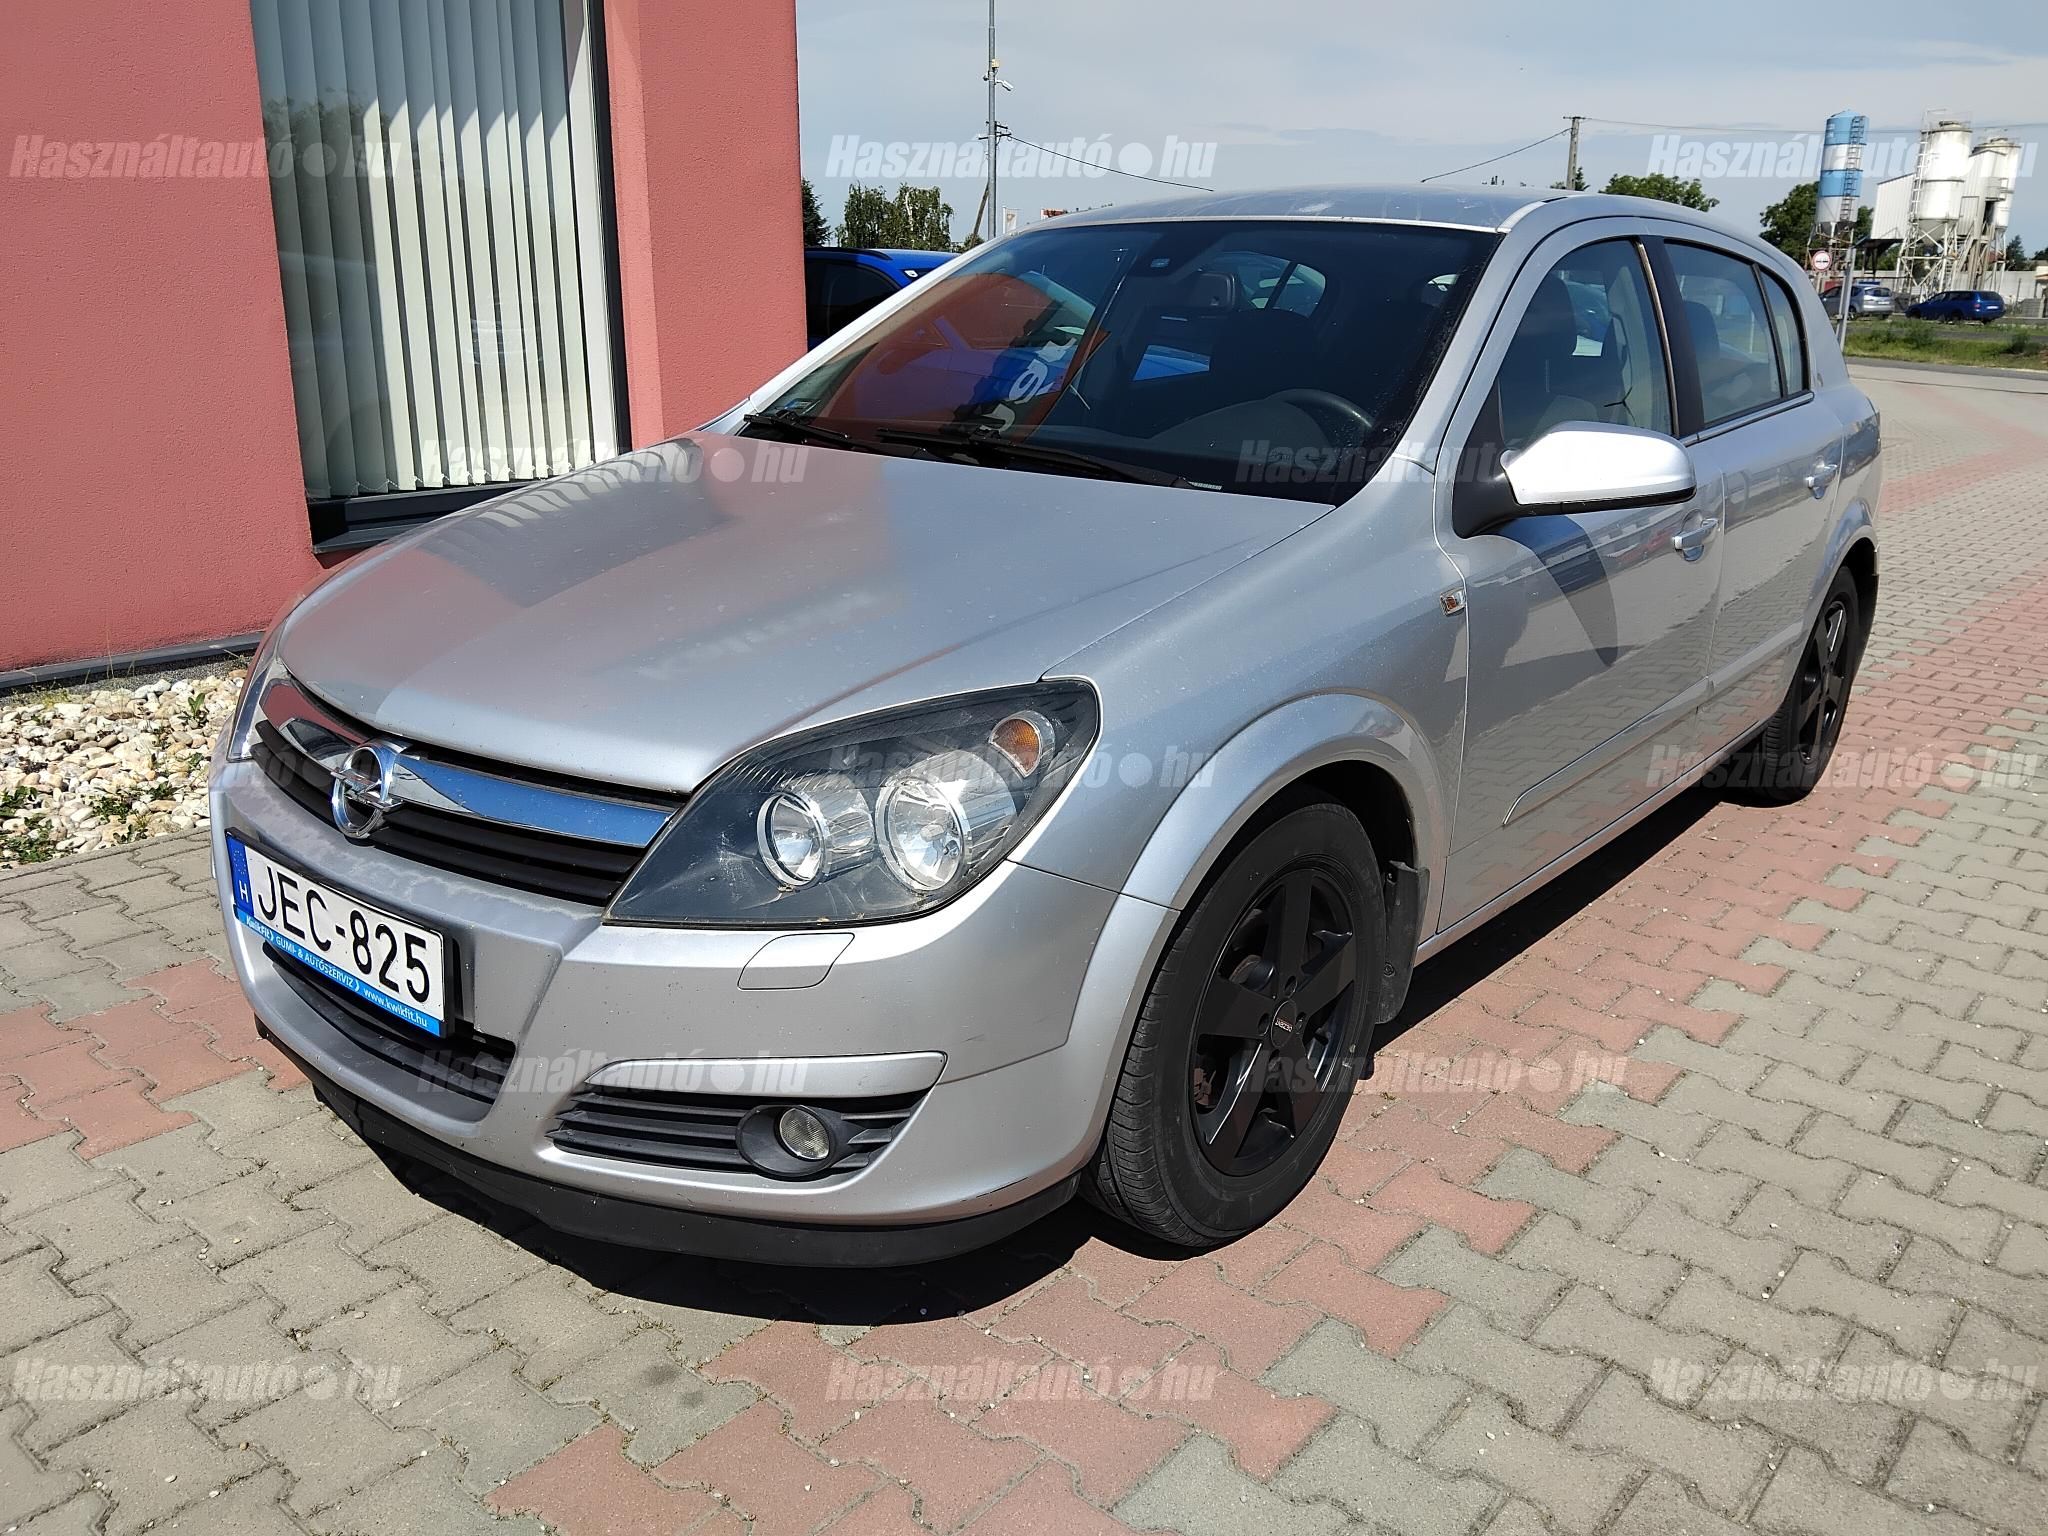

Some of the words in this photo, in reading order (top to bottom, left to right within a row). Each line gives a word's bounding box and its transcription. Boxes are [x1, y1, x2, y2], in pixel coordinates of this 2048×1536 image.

[238, 880, 249, 903] H
[257, 865, 431, 1003] JEC-825
[363, 988, 429, 1028] www.kwikfit.hu
